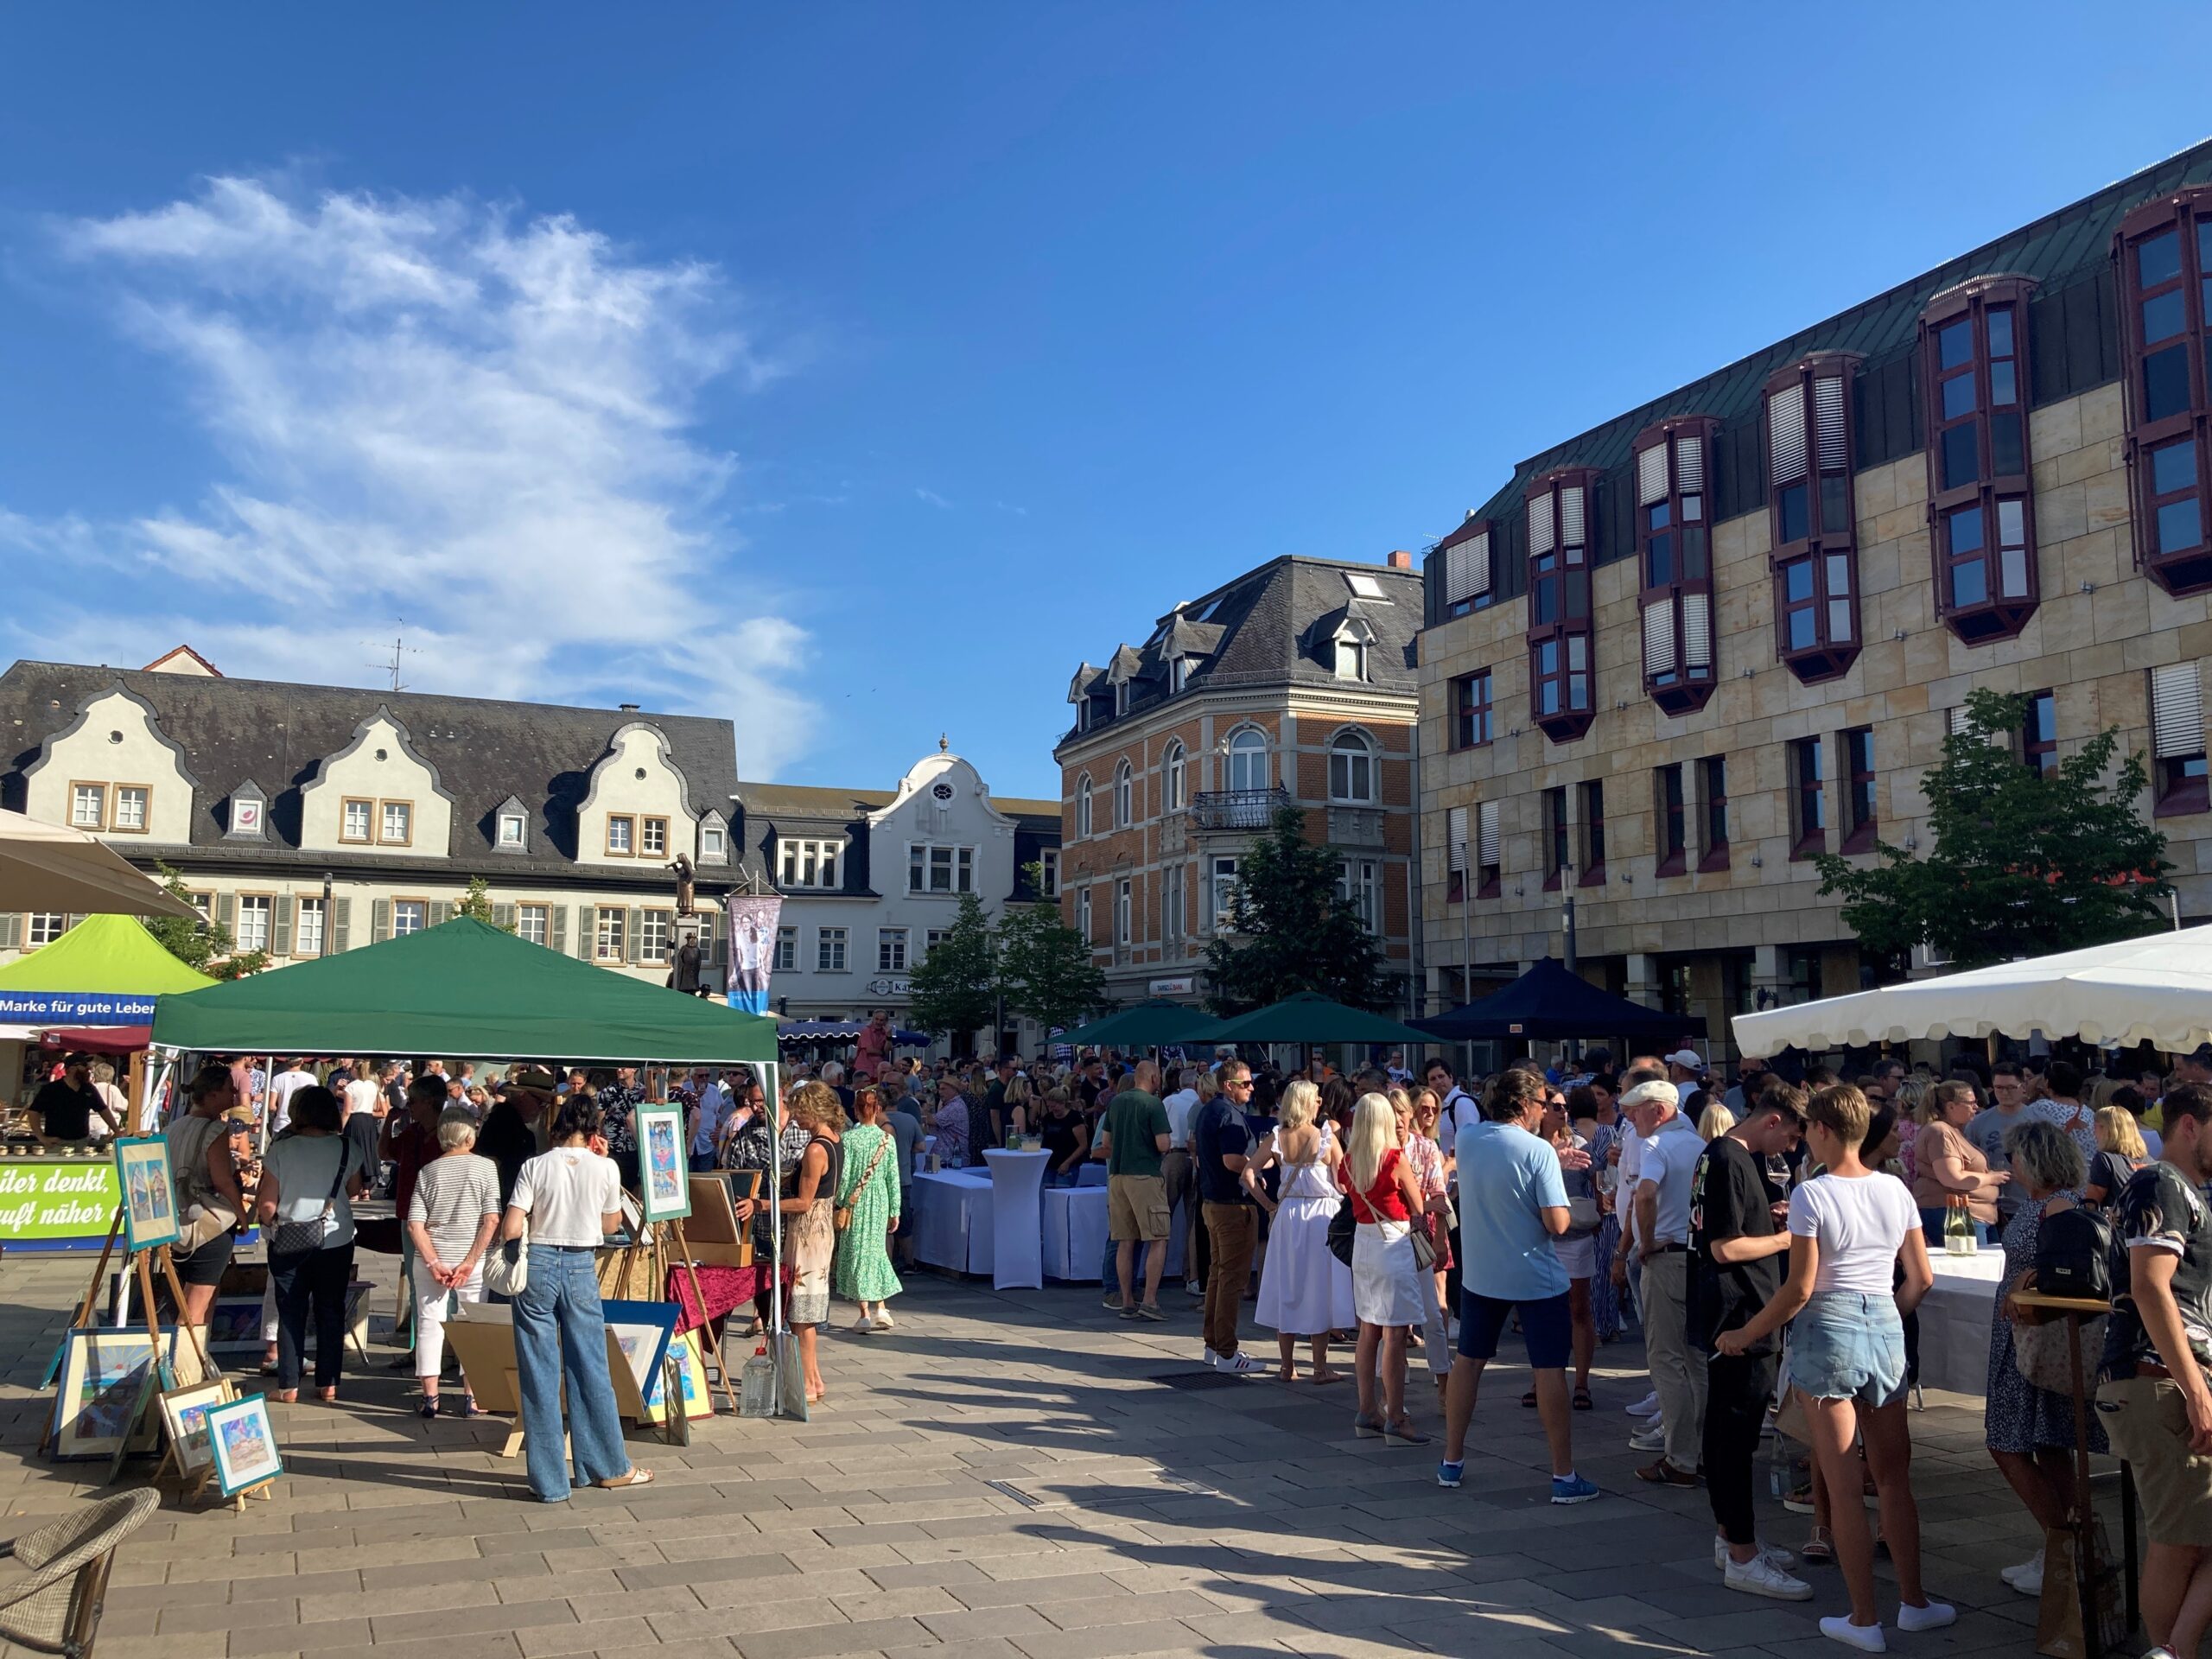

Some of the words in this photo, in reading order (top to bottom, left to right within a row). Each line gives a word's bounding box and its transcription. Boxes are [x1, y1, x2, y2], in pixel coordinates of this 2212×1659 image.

[0, 1000, 47, 1012] Marke
[51, 1001, 73, 1012] für
[77, 1001, 111, 1015] gute
[43, 1168, 109, 1193] denkt,
[39, 1199, 105, 1225] näher
